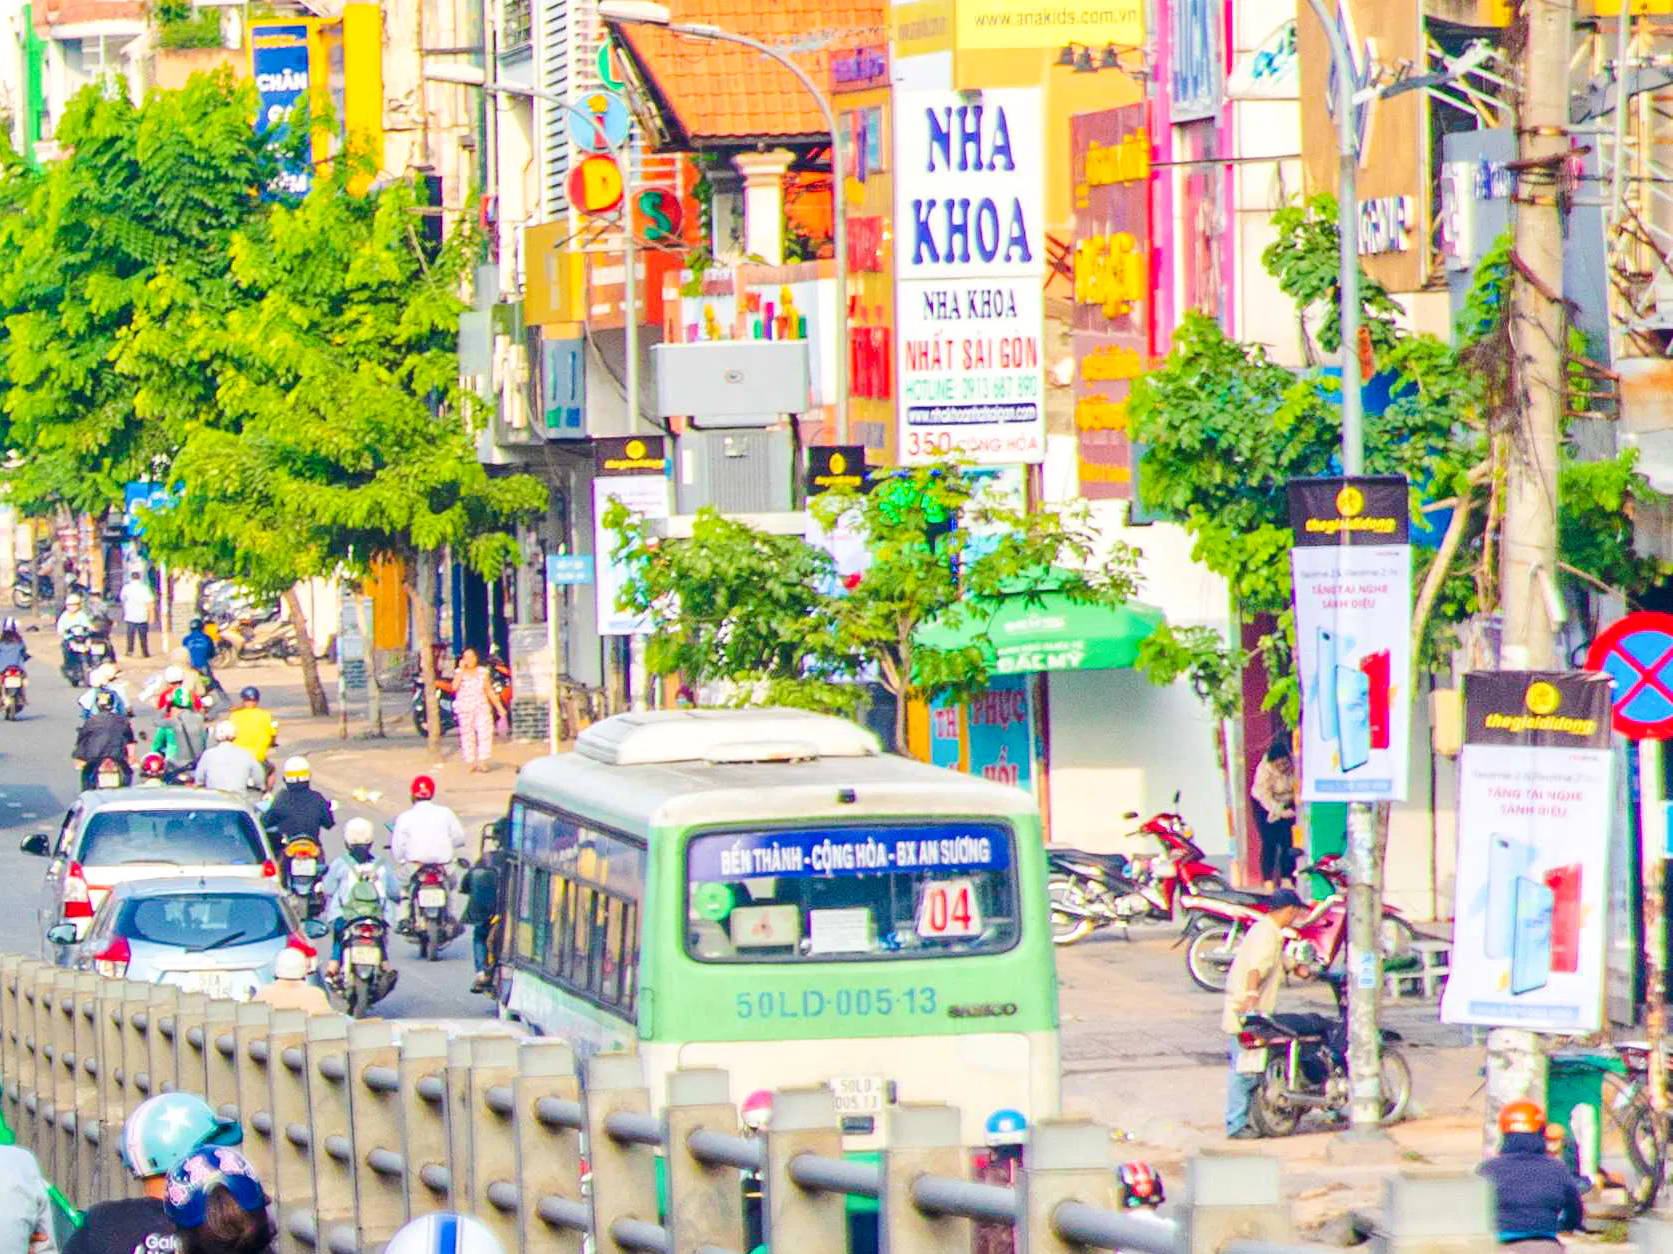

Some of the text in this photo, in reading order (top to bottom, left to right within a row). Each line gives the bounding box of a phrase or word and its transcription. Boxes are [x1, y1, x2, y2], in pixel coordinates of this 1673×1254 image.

[974, 8, 1137, 28] www.anakids.com.vn
[925, 105, 1016, 173] NHA
[911, 197, 1033, 266] KHOA
[923, 287, 1018, 321] NHA KHOA
[905, 328, 954, 372] NHẤT
[720, 840, 753, 876] BẾN
[753, 842, 804, 873] THÀNH
[811, 839, 854, 879] CỘNG
[855, 836, 889, 869] HÒA
[895, 840, 918, 868] BX
[919, 840, 939, 866] AN
[929, 887, 972, 932] 04
